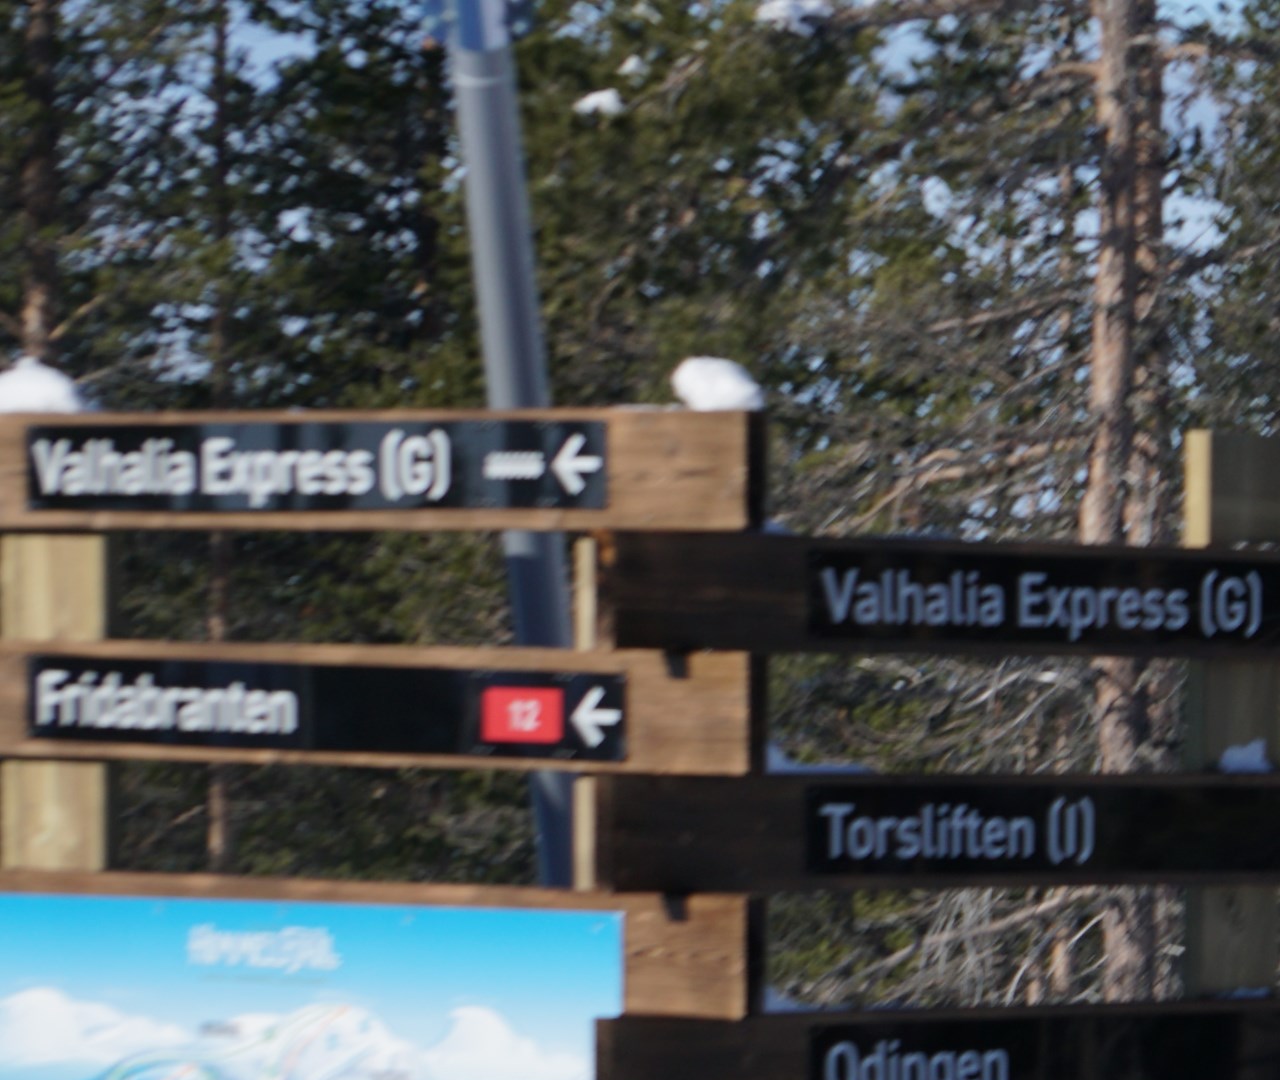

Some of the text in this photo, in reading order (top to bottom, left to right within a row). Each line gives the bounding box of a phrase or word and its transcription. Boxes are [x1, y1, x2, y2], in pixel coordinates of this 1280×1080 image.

[201, 437, 376, 508] Express
[380, 429, 451, 501] (G)
[1018, 572, 1189, 640] Express
[1201, 571, 1262, 638] (G)
[36, 670, 297, 734] Fridabranten
[507, 699, 541, 732] 12
[821, 803, 1035, 859] Torsliften
